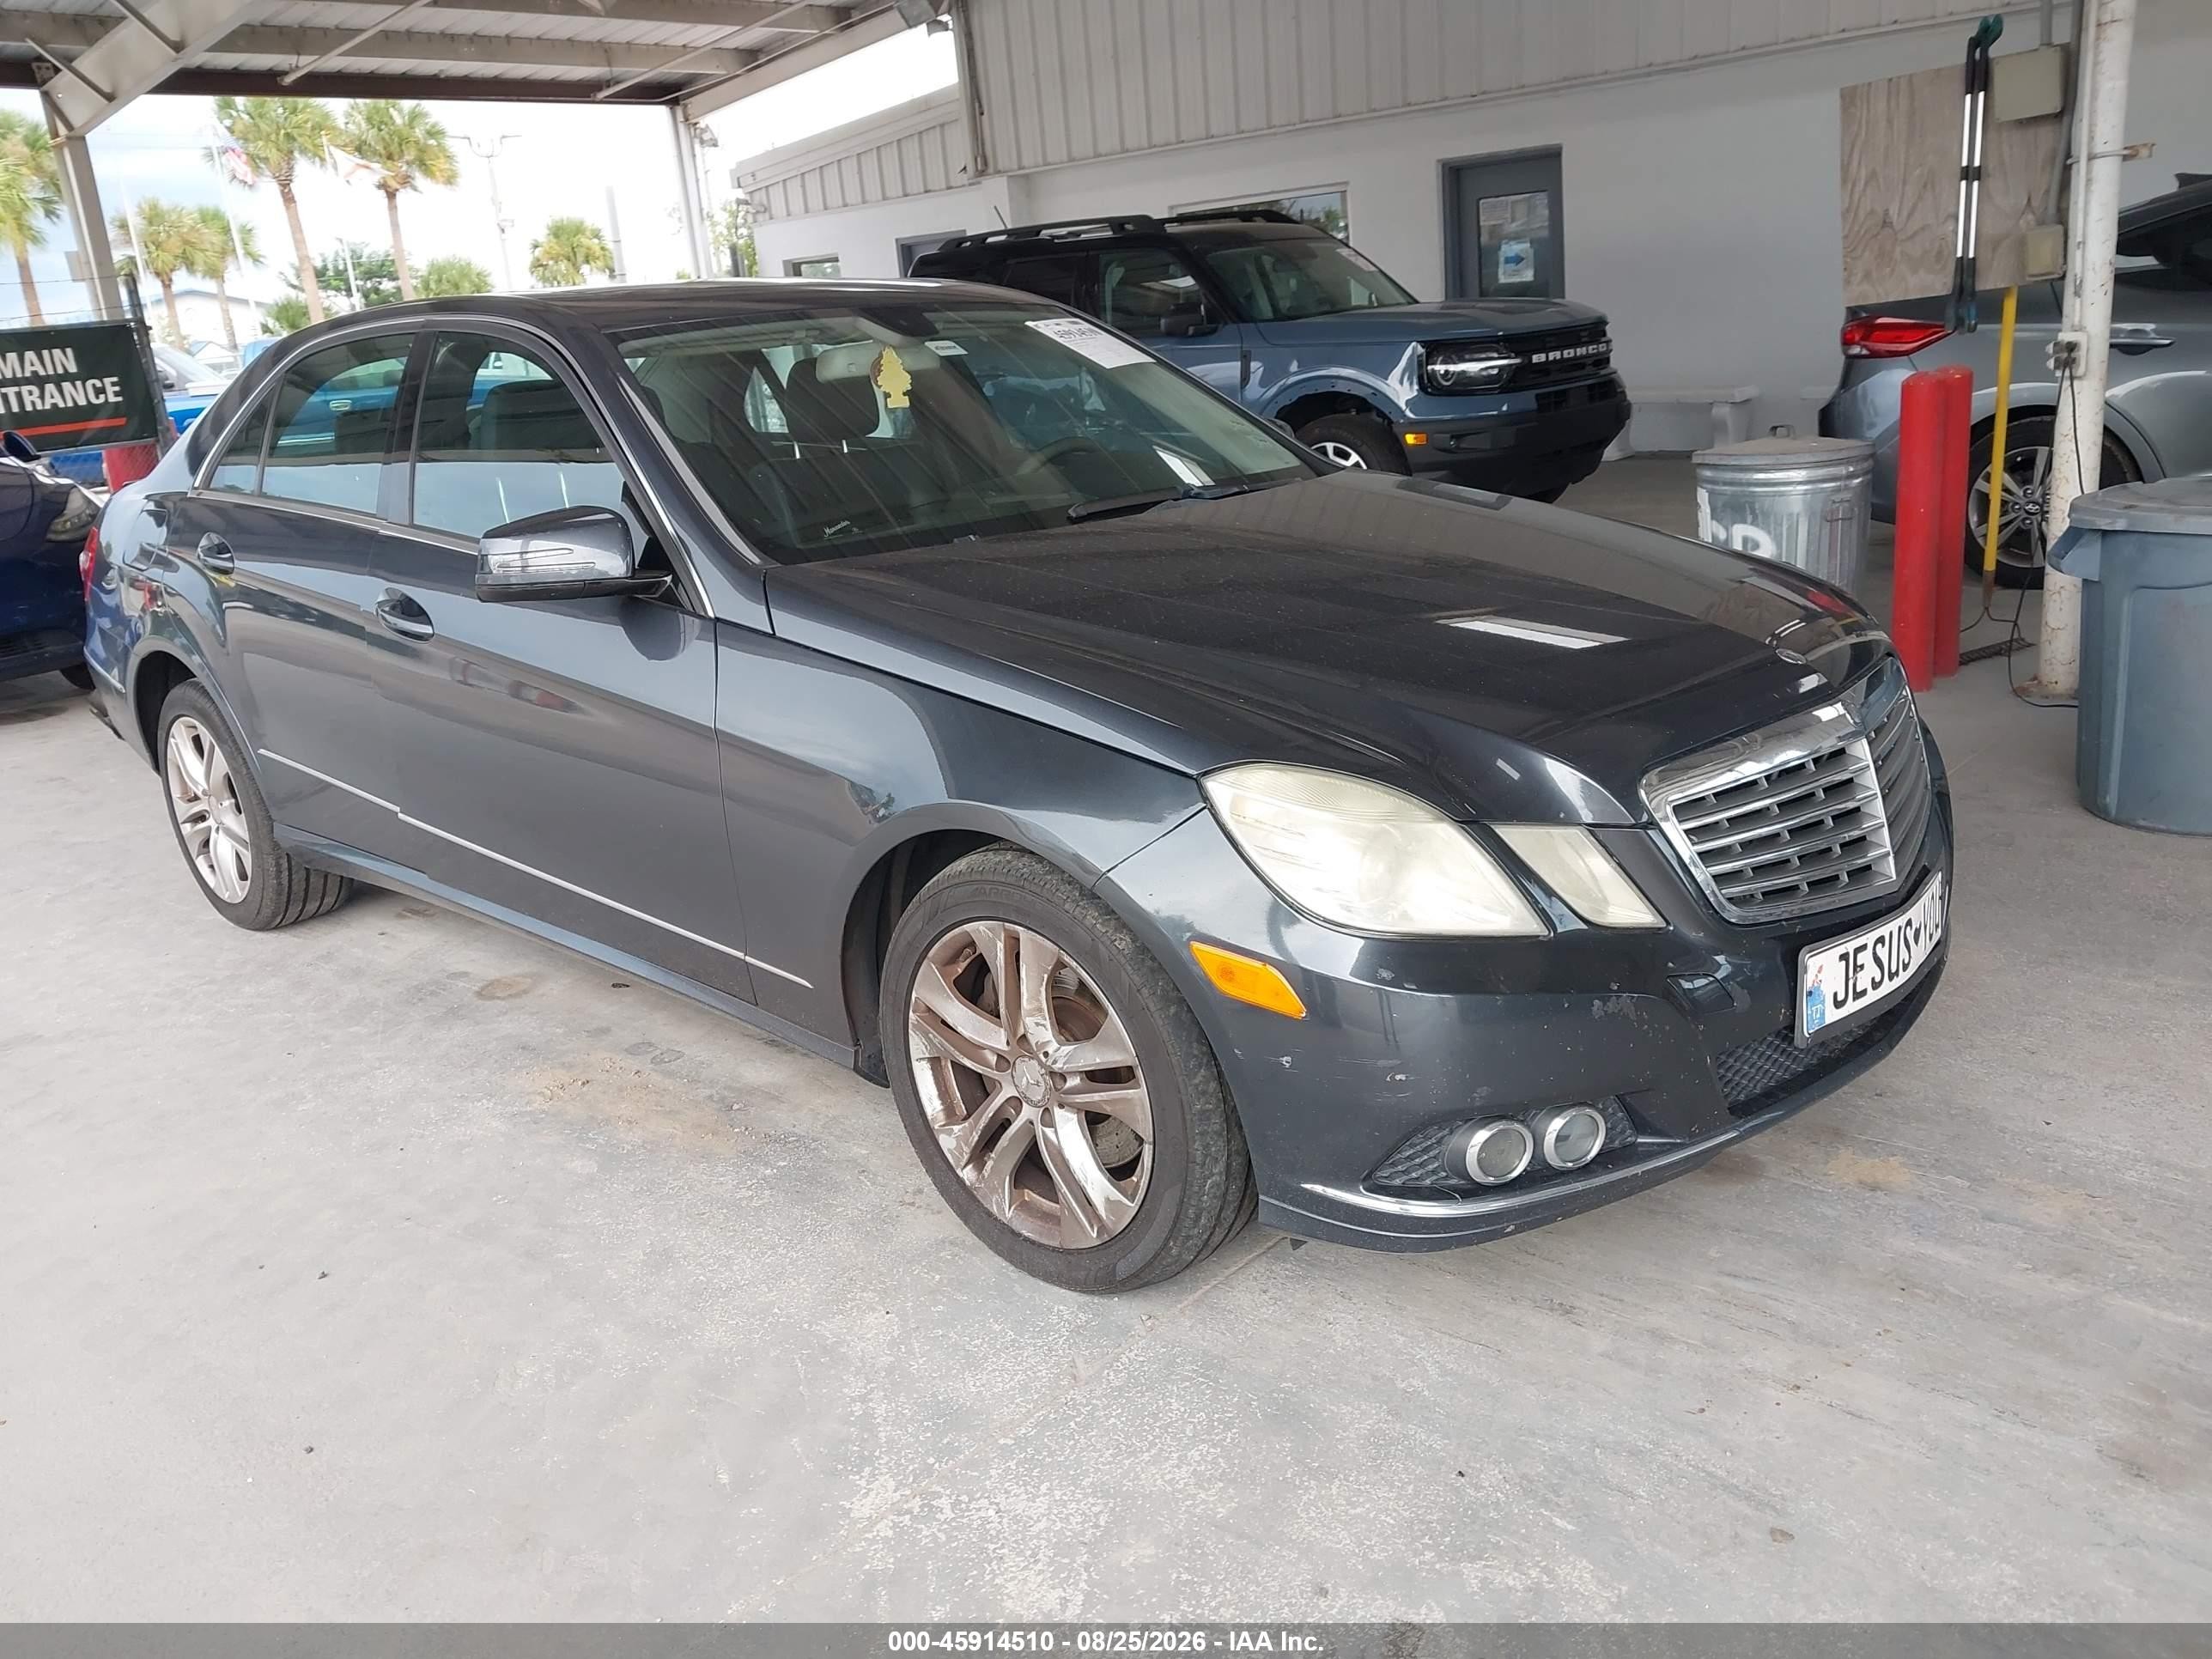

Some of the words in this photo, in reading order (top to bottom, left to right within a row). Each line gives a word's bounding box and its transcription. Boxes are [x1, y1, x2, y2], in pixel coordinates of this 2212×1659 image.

[0, 348, 78, 380] MAIN
[1531, 343, 1607, 363] BRONCO
[0, 376, 123, 414] TRANCE
[1832, 917, 1913, 1010] JESUS
